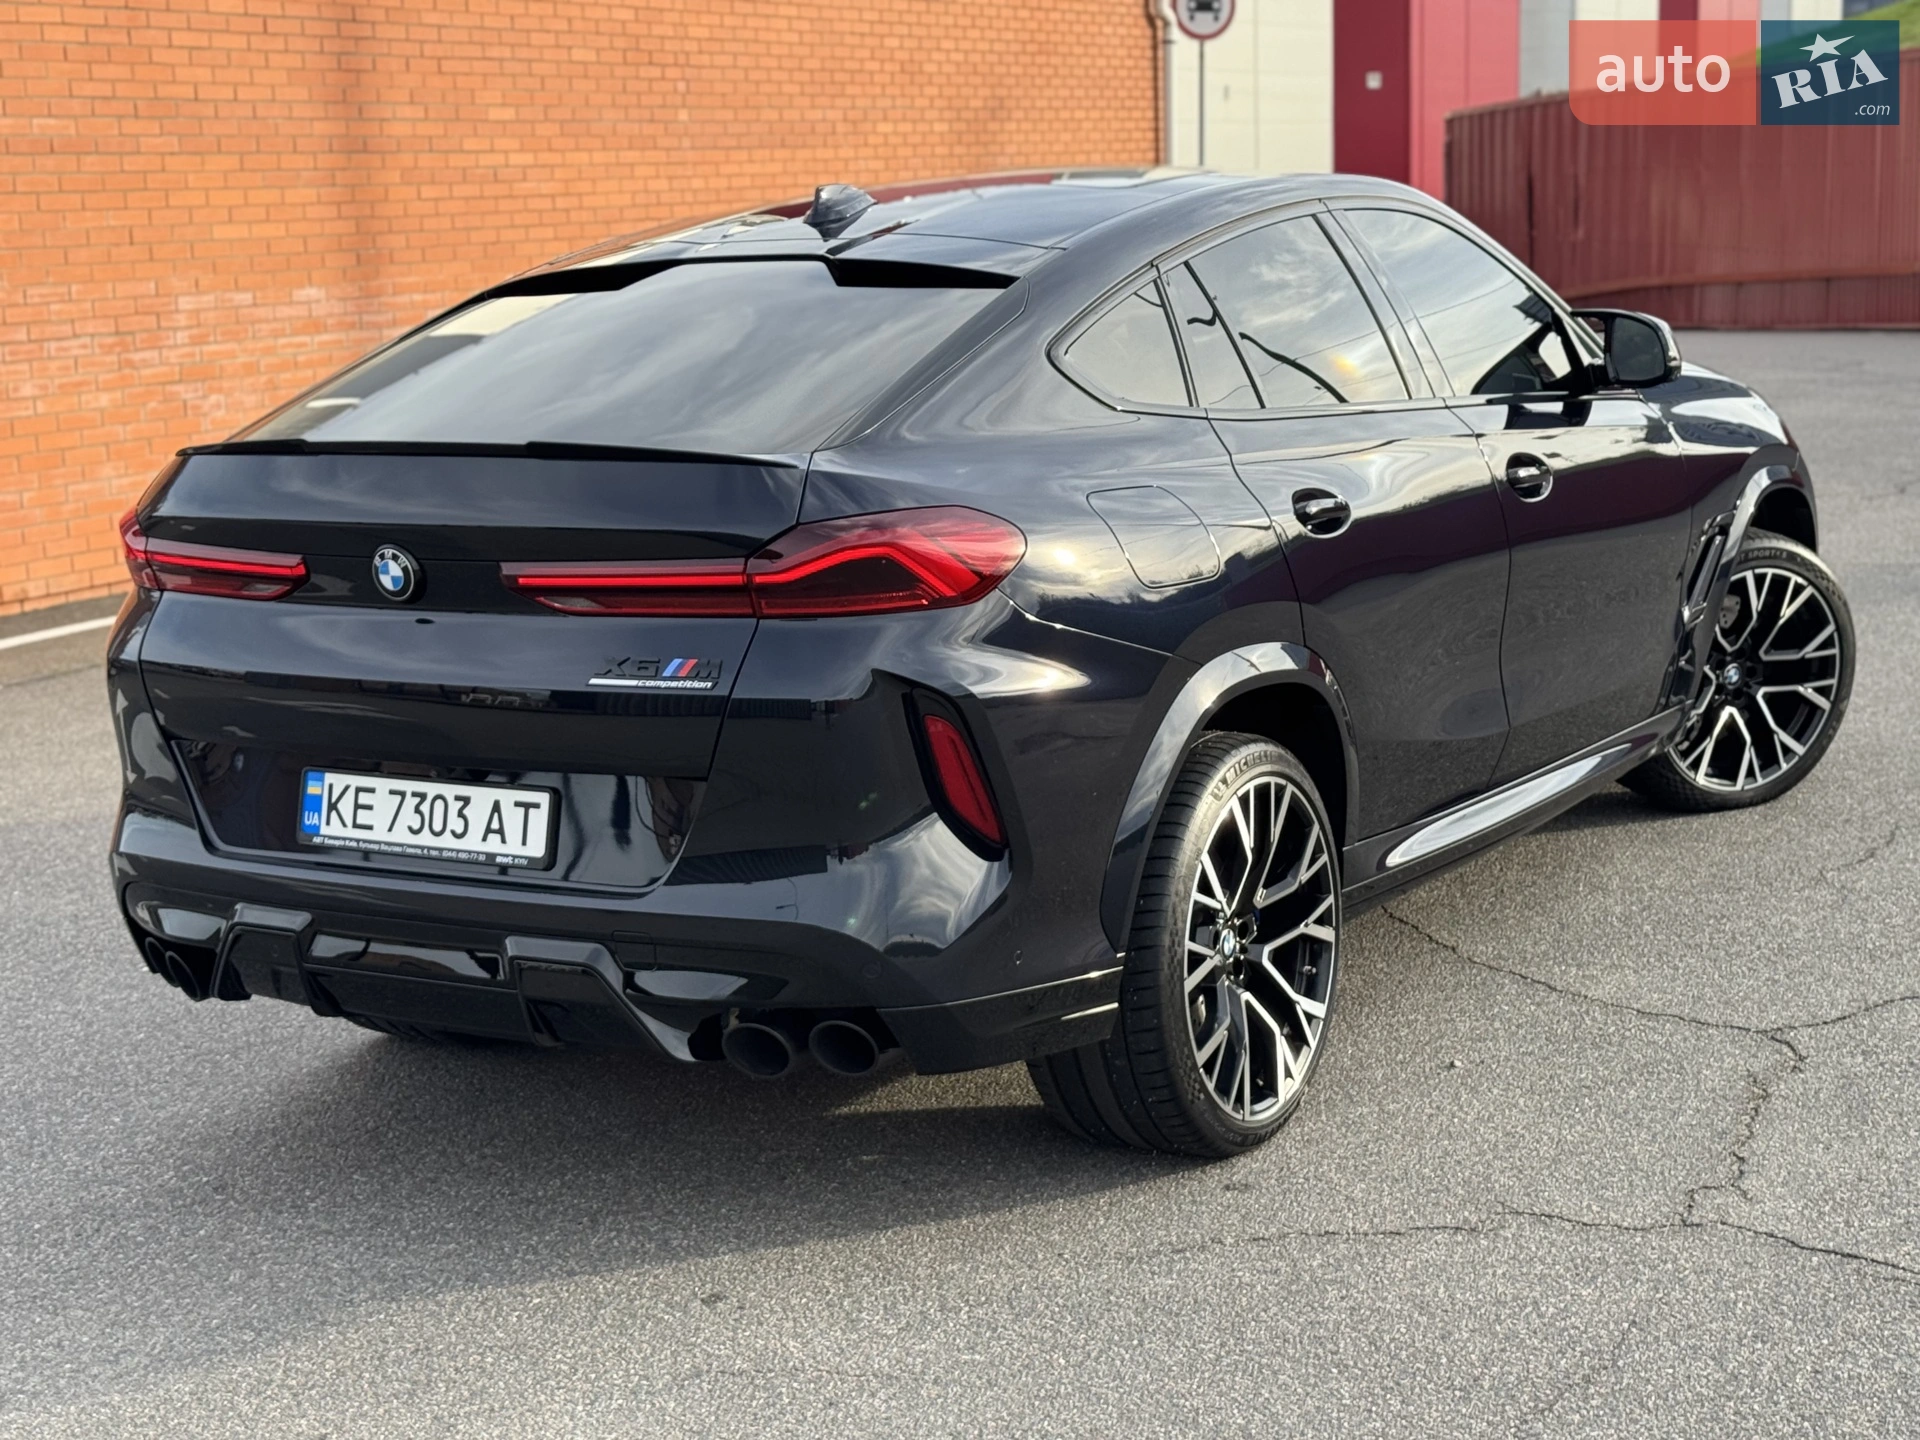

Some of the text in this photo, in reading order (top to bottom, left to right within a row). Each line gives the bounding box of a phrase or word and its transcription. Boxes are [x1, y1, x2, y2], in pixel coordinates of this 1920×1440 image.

[594, 656, 661, 678] X6
[637, 679, 713, 689] competition
[304, 810, 320, 826] UA
[326, 783, 541, 846] KE 7303 AT
